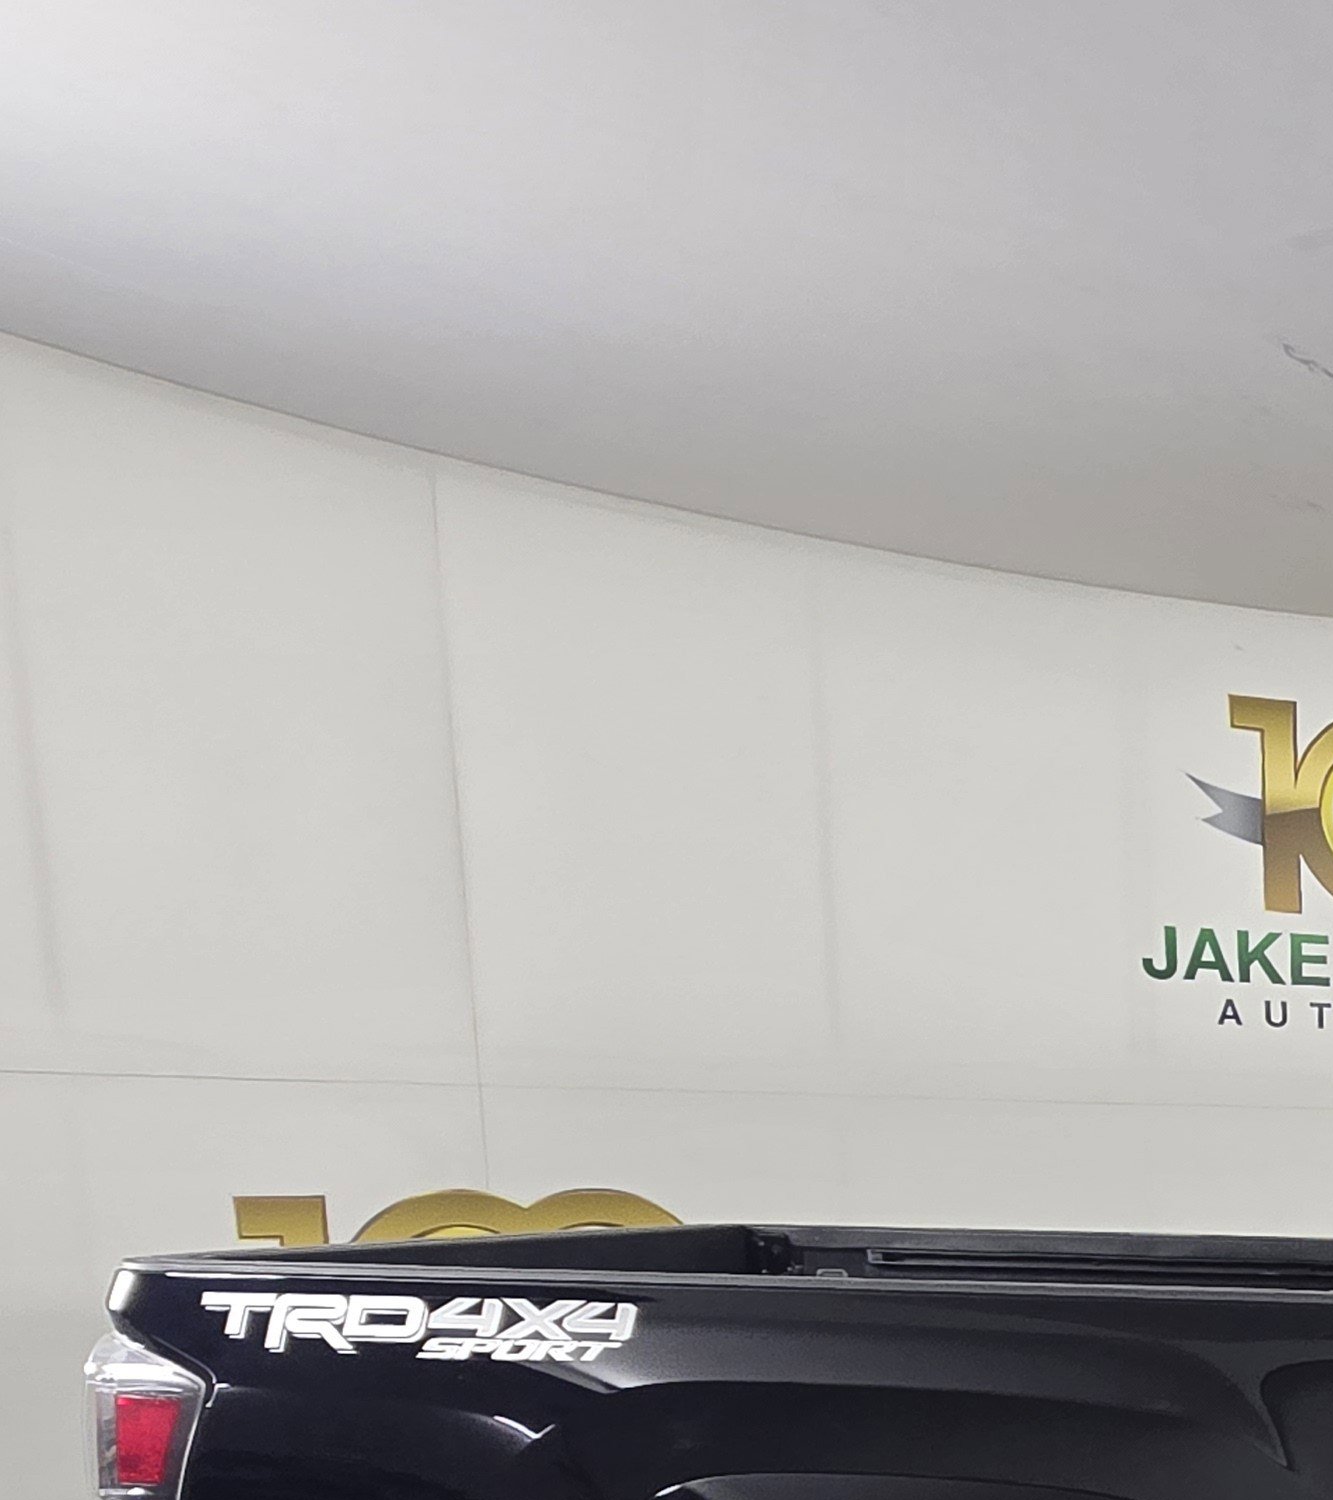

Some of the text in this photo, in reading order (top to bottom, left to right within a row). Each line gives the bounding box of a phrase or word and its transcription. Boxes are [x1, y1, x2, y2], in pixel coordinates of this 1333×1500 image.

[1141, 925, 1331, 988] JAKE
[201, 1291, 430, 1355] TRD
[415, 1337, 624, 1362] SPORT
